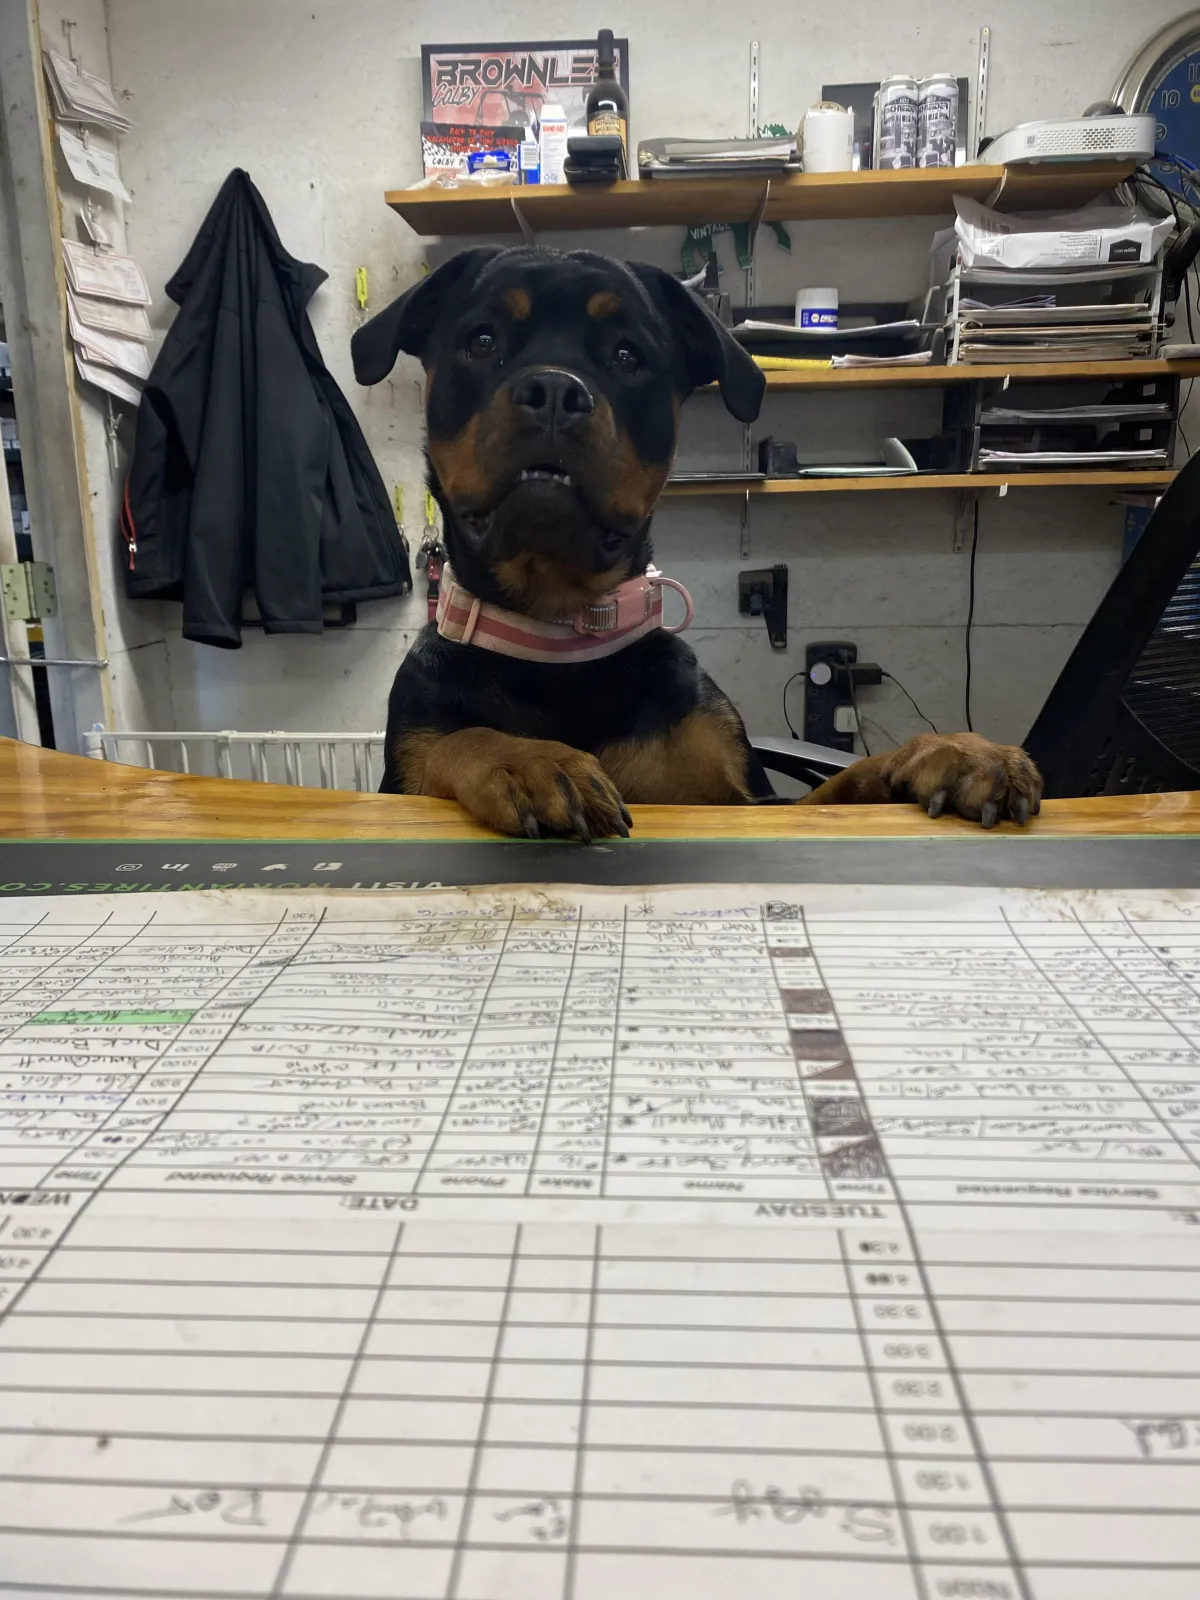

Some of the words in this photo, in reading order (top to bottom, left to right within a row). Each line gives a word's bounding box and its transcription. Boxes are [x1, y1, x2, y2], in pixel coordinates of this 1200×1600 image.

[432, 81, 482, 108] COLBY
[1161, 89, 1180, 109] 10
[691, 222, 731, 239] VINTAGE
[282, 1173, 358, 1186] Service
[440, 1176, 508, 1189] Phone
[538, 1177, 594, 1190] Make
[683, 1180, 745, 1192] Name
[836, 1182, 886, 1195] Time
[956, 1184, 1073, 1197] Requested
[1077, 1186, 1160, 1200] Service
[338, 1195, 419, 1211] DATE:
[754, 1204, 886, 1219] TUESDAY
